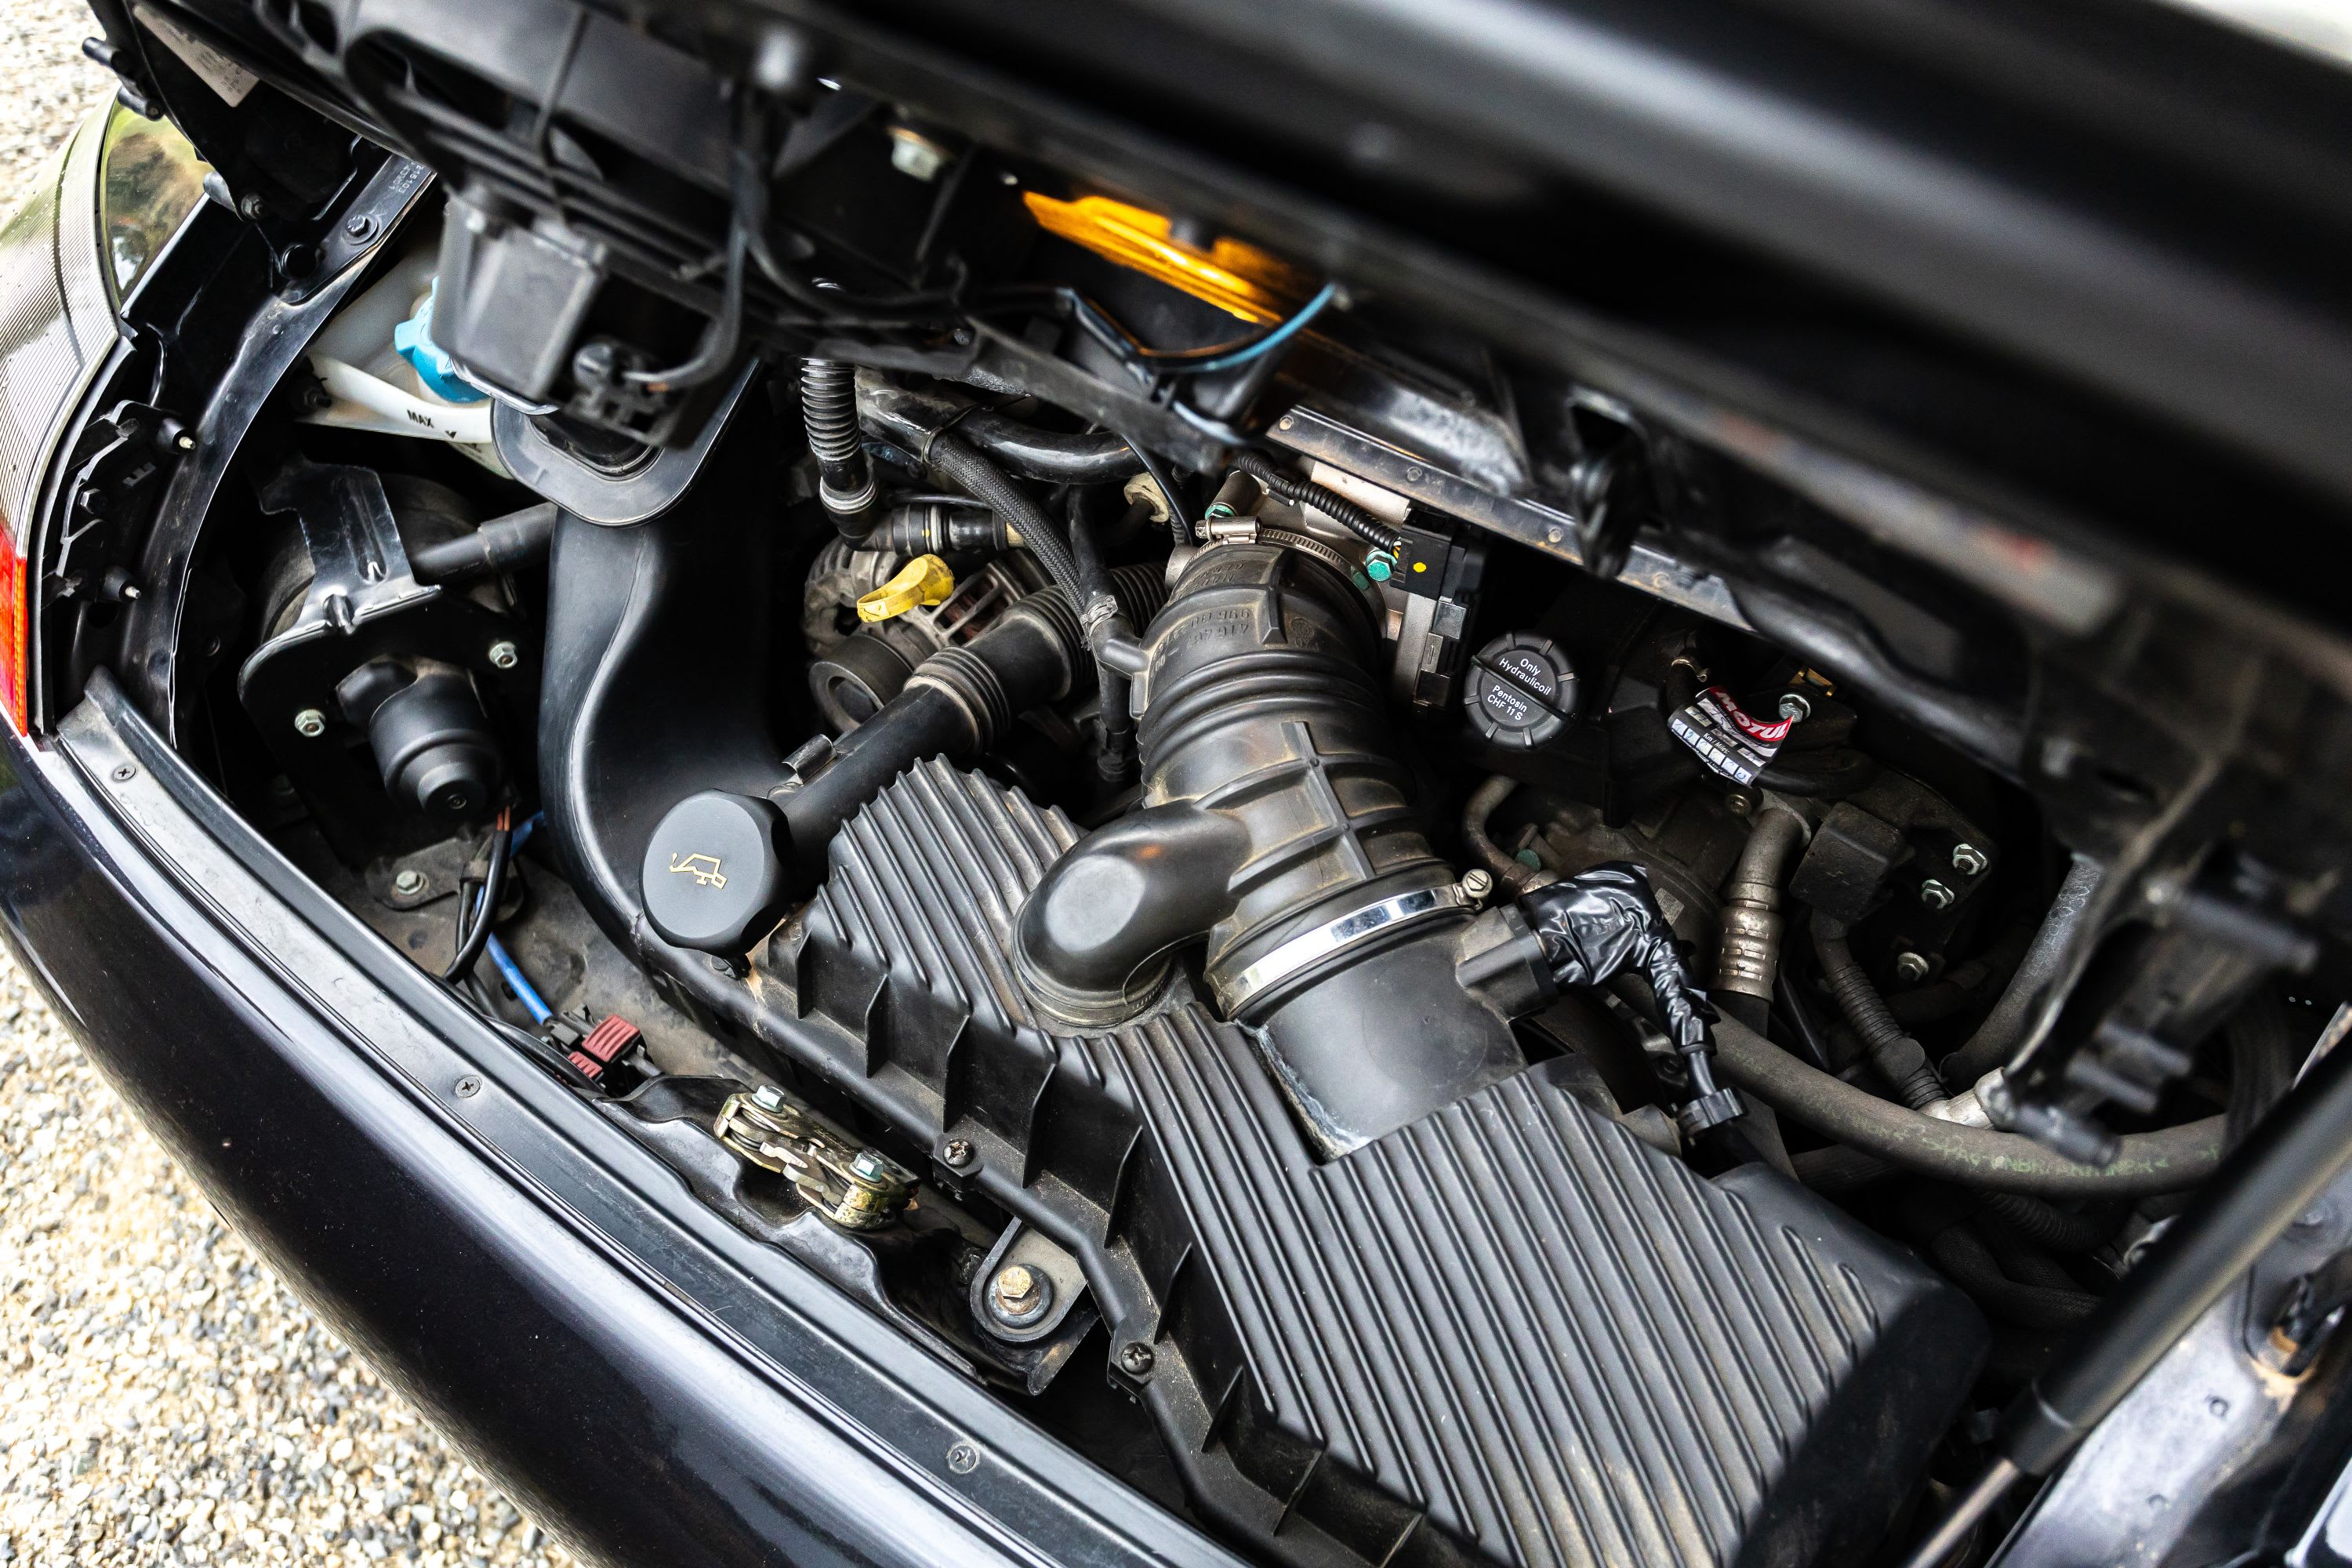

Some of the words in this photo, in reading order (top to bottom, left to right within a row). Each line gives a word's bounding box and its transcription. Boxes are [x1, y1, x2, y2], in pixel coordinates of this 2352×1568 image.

[407, 409, 434, 429] MAX
[1498, 658, 1552, 696] Hydraulicoil
[1520, 658, 1541, 677] Only
[1486, 694, 1505, 709] CHF
[1506, 705, 1515, 717] 11
[1515, 712, 1523, 720] S
[1492, 685, 1528, 713] Pentosin
[1715, 691, 1788, 739] MOTUL
[1703, 732, 1713, 742] Km
[1714, 741, 1730, 755] Miles:
